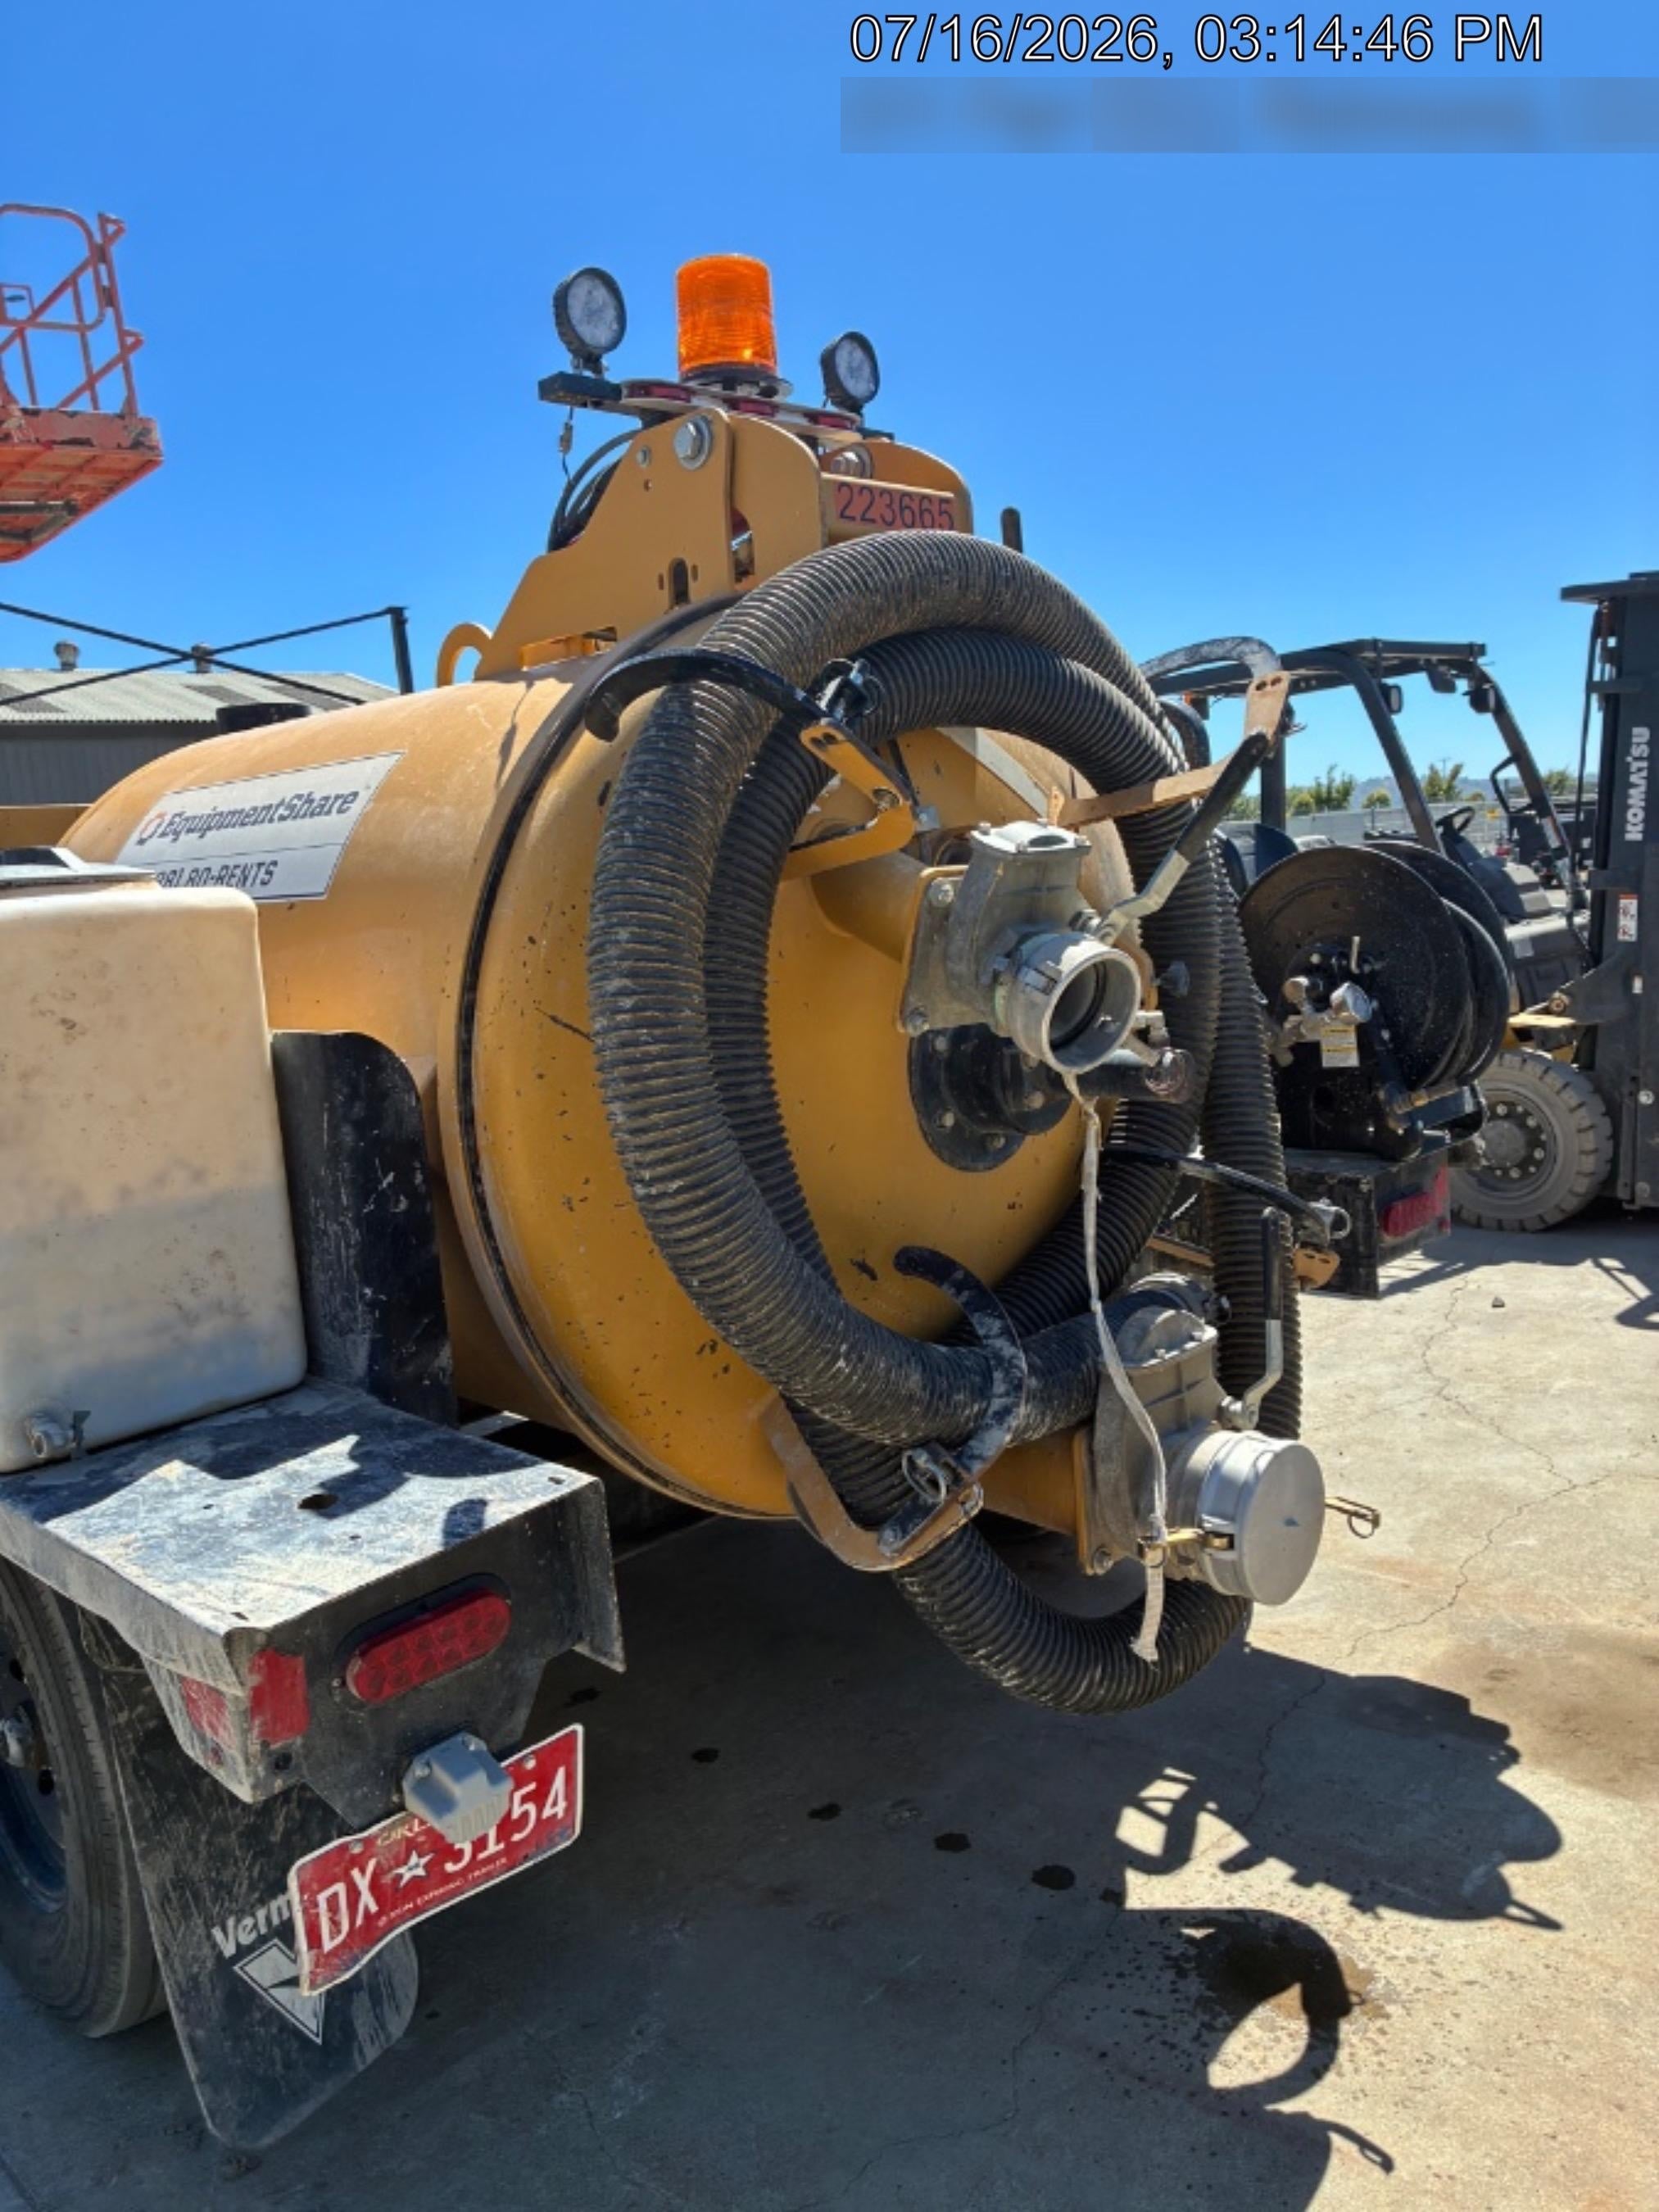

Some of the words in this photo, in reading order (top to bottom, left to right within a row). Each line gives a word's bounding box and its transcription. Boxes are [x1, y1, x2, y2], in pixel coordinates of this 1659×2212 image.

[837, 483, 954, 529] 223665
[156, 791, 360, 843] EquipmentShare
[1625, 727, 1650, 841] KOMATSU
[211, 1893, 291, 1959] Verm
[317, 1857, 379, 1953] DX
